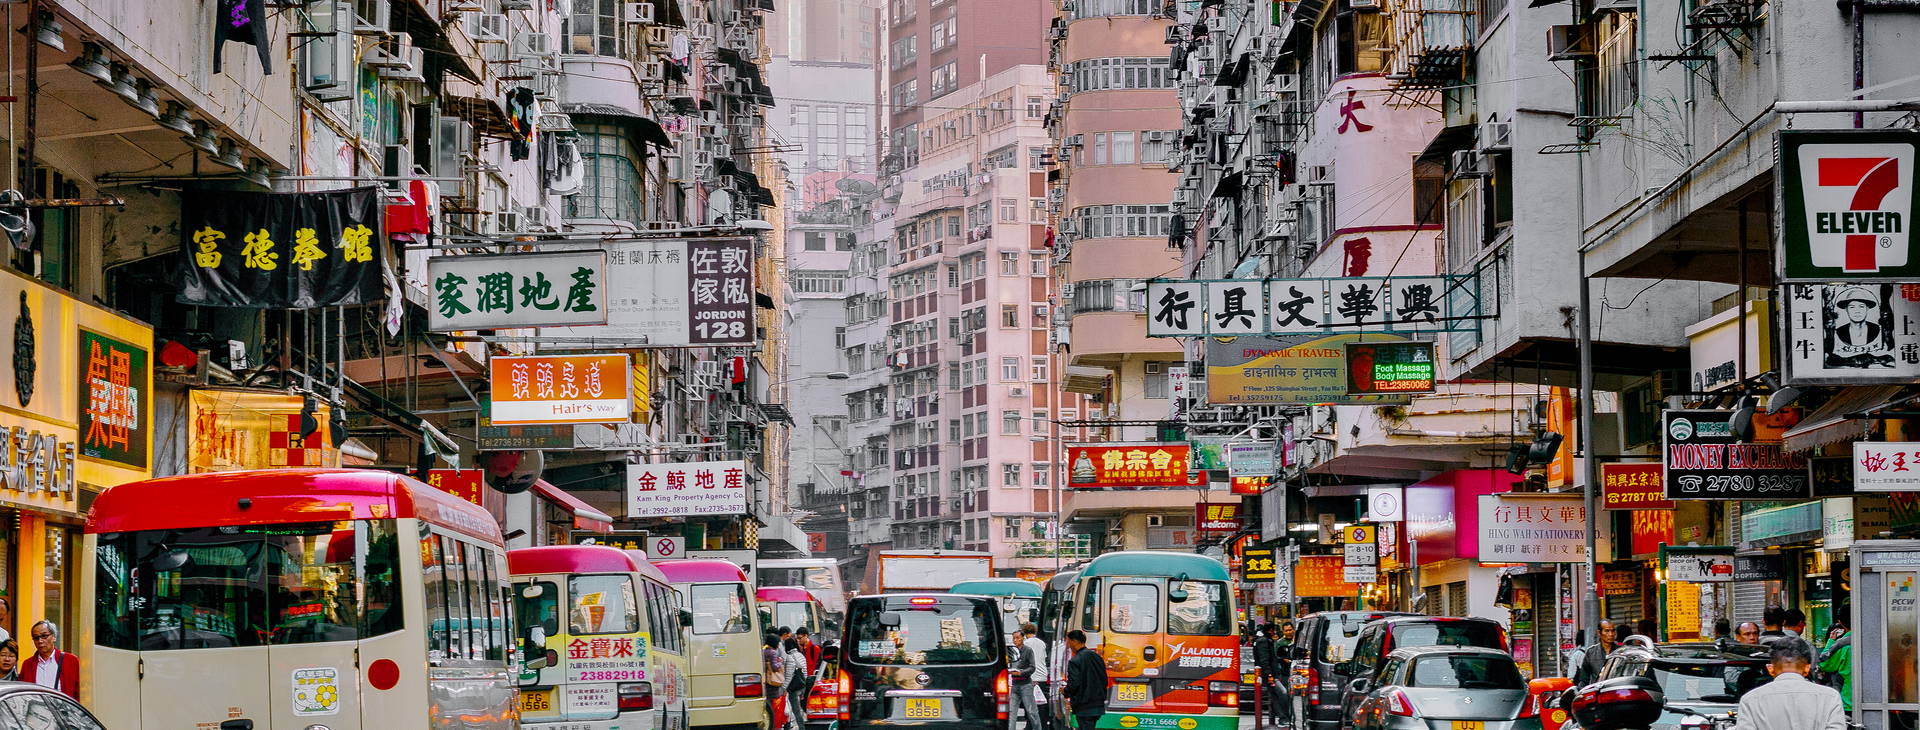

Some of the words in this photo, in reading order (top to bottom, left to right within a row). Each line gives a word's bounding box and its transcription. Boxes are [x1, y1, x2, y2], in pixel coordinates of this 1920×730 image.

[192, 224, 374, 272] 富德拳館
[690, 246, 749, 275] 佐敦
[434, 266, 598, 320] 家潤地產
[694, 310, 746, 320] JORDON
[695, 321, 746, 339] 128
[1242, 348, 1294, 358] DYNAMIC
[1295, 348, 1341, 358] TRAVELS
[1375, 365, 1394, 373] Foot
[1396, 364, 1431, 373] Massage
[1375, 372, 1395, 381] Body
[1396, 372, 1431, 380] Massage
[552, 404, 593, 415] Hair's
[1669, 443, 1725, 470] MONEY
[1706, 475, 1755, 491] 2780
[1758, 475, 1807, 492] 3287
[674, 494, 703, 502] Property
[705, 493, 731, 501] Agency
[1621, 492, 1645, 502] 2787
[1488, 529, 1510, 539] HING
[1513, 529, 1531, 539] WAH
[1534, 529, 1585, 540] STATIONERY
[568, 637, 633, 660] 金寶來
[1181, 647, 1234, 657] LALAMOVE
[580, 670, 646, 681] 23882918
[907, 708, 941, 717] 3858
[1140, 717, 1157, 725] 2751
[1159, 717, 1178, 726] 6666
